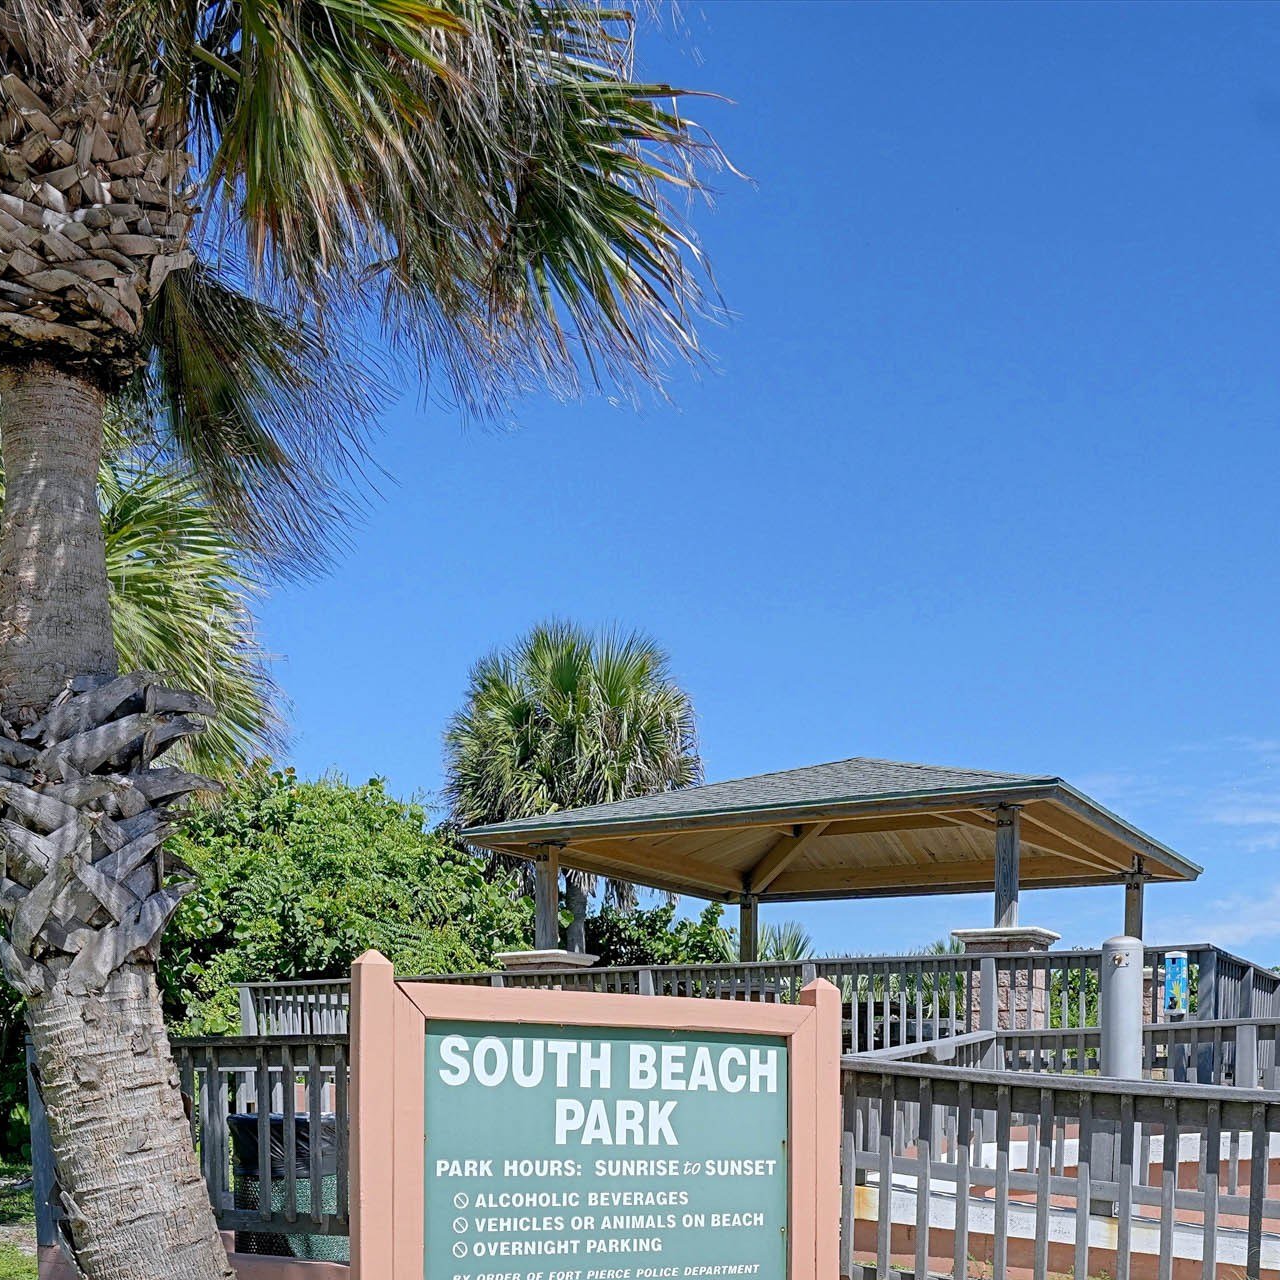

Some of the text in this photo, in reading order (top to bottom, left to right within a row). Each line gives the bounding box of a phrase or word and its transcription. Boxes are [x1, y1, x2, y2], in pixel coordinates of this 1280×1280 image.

[439, 1034, 777, 1093] SOUTH BEACH
[555, 1099, 679, 1146] PARK
[436, 1160, 776, 1177] PARK HOURS: SUNRISE to SUNSET
[475, 1191, 688, 1209] ALCOHOLIC BEVERAGES
[475, 1212, 764, 1232] VEHICLES OR ANIMALS ON BEACH
[473, 1238, 662, 1257] OVERNIGHT PARKING
[548, 1270, 581, 1280] FORT
[587, 1268, 630, 1279] PIERCE
[636, 1267, 678, 1278] POLICE
[684, 1264, 759, 1276] DEPARTMENT
